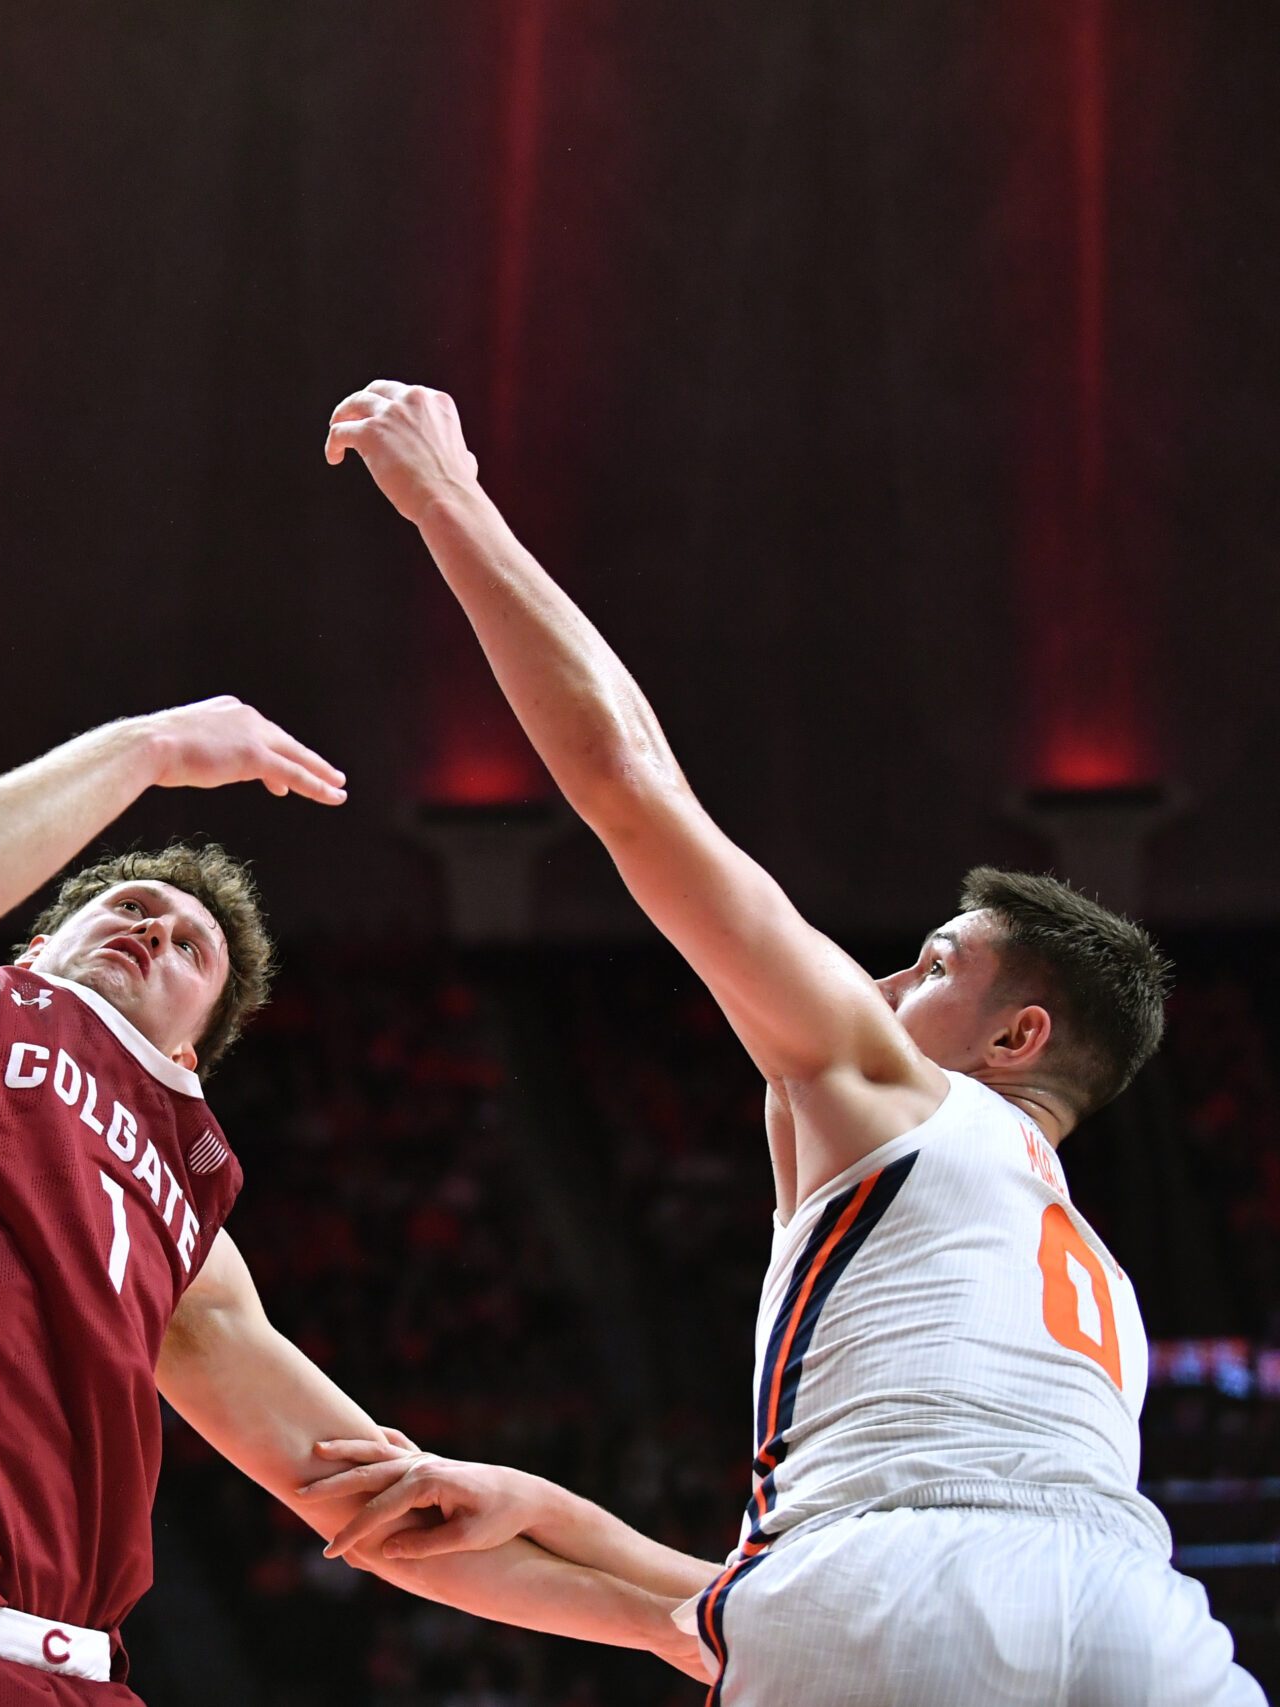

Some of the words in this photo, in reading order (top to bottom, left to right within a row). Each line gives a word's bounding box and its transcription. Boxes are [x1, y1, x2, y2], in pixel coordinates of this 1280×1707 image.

[4, 1042, 200, 1274] COLGATE
[99, 1169, 131, 1296] 1
[1037, 1203, 1123, 1392] 0
[41, 1628, 72, 1665] C
